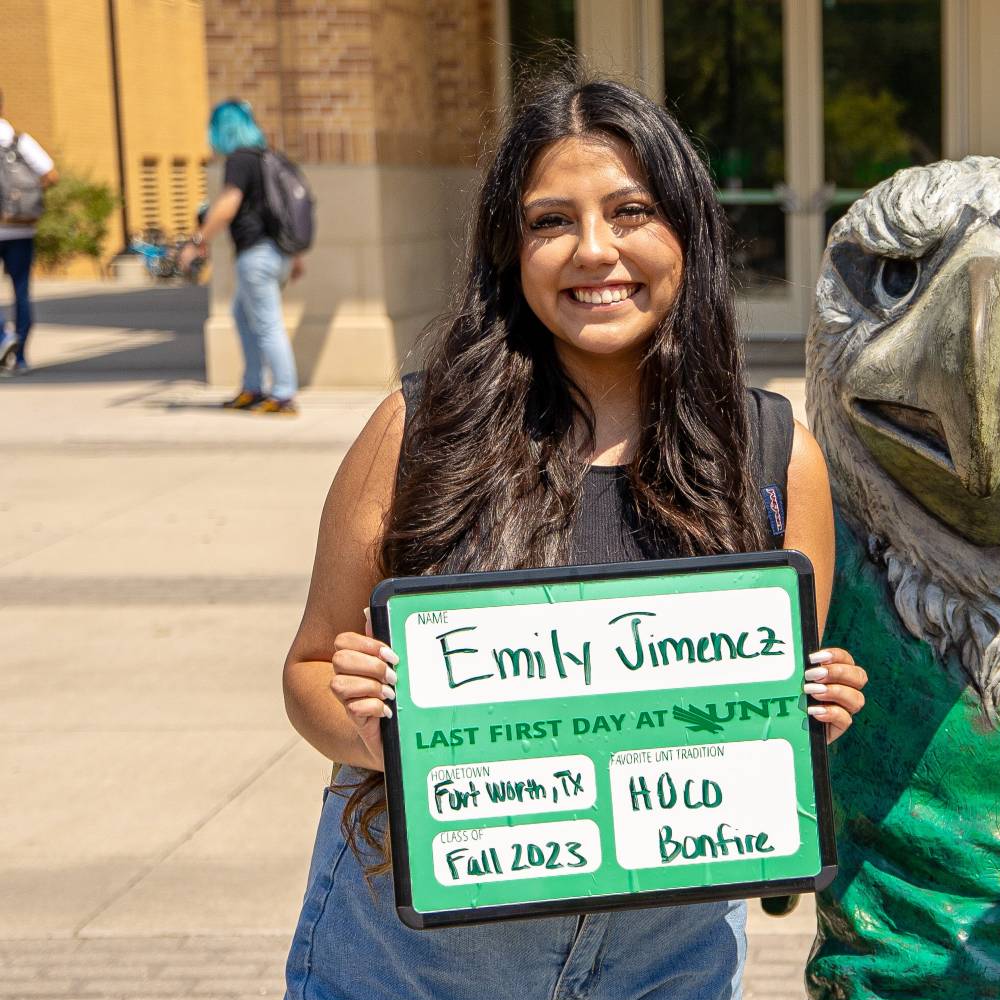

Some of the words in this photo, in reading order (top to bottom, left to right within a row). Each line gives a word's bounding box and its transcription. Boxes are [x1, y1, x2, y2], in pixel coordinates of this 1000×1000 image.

[417, 611, 449, 625] NAME
[435, 626, 592, 689] Emily
[415, 727, 479, 750] LAST
[489, 719, 563, 743] FIRST
[572, 713, 626, 735] DAY
[636, 710, 668, 729] AT
[705, 695, 799, 723] UNT
[610, 751, 652, 765] FAVORITE
[655, 749, 673, 763] UNT
[676, 745, 725, 760] TRADITION
[431, 766, 490, 782] HOMETOWN
[440, 830, 469, 844] CLASS
[471, 829, 484, 841] OF
[658, 823, 775, 864] Bonfire
[446, 847, 504, 880] Fall
[511, 841, 588, 872] 2023
